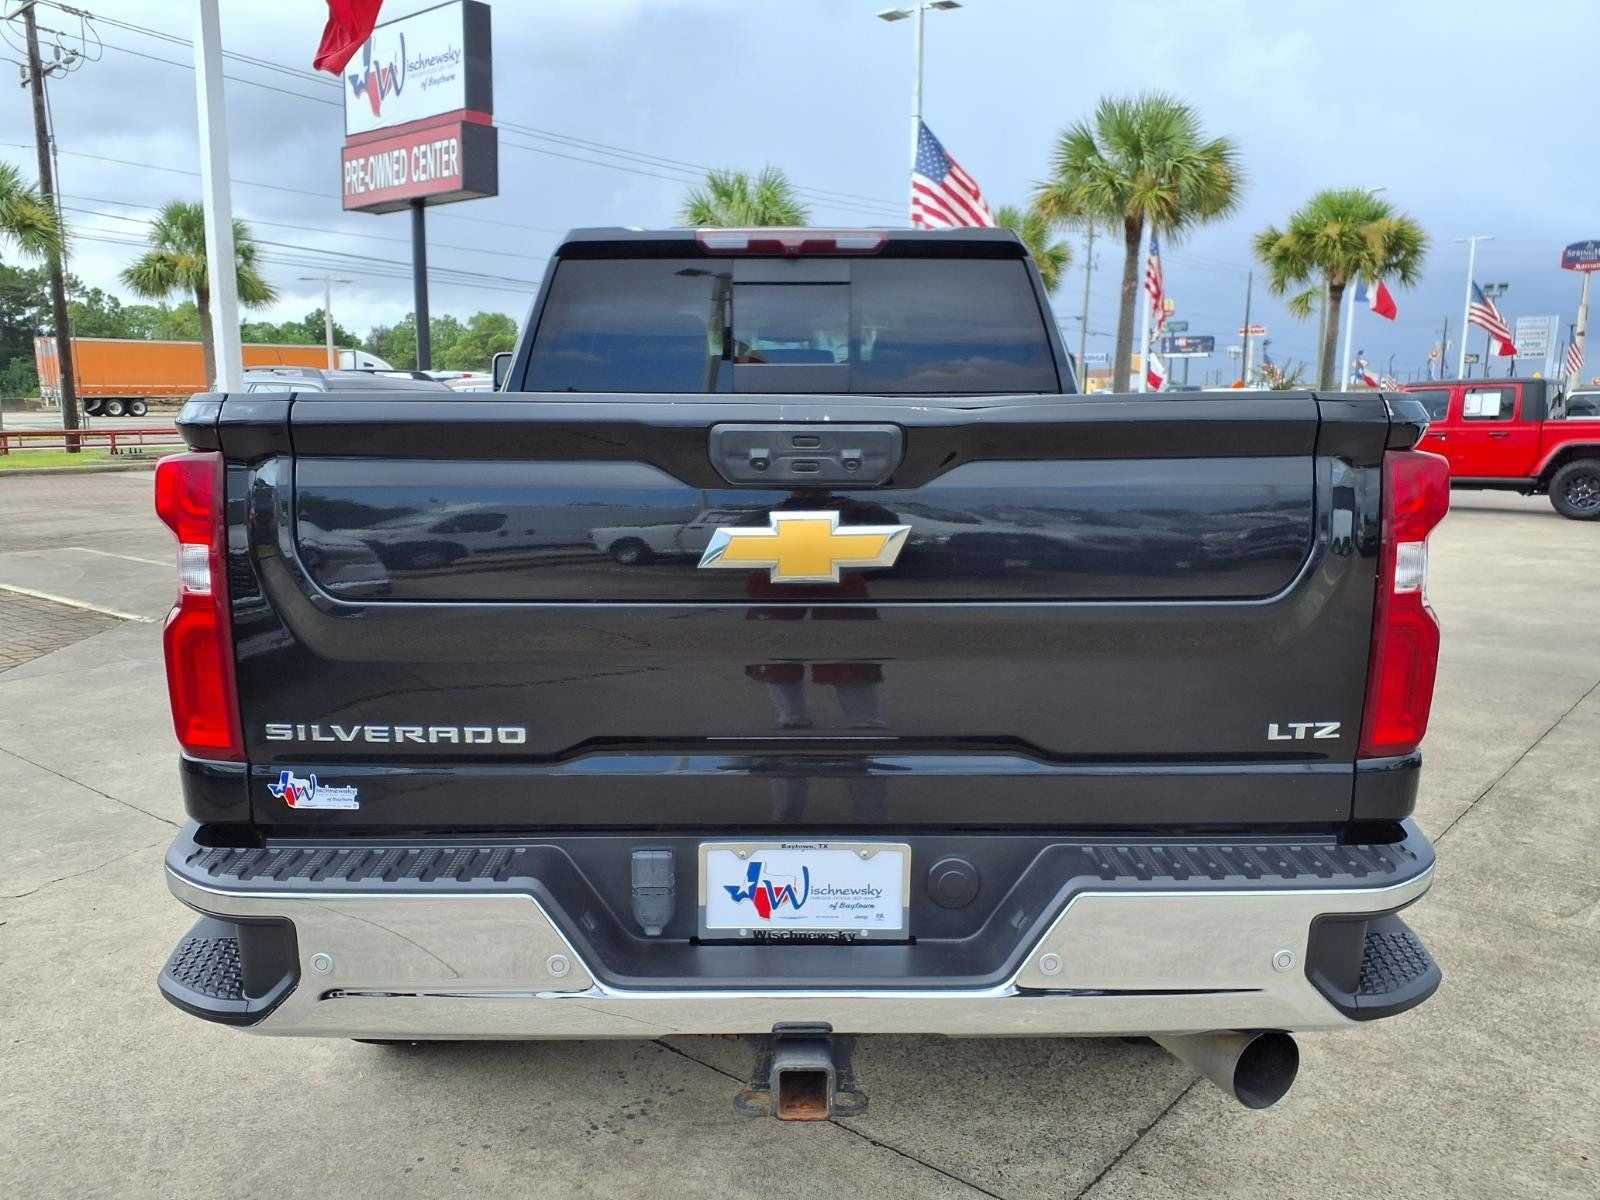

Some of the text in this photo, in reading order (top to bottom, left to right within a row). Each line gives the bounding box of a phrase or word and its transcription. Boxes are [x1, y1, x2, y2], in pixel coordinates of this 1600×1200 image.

[373, 32, 461, 101] Wischnewsky
[344, 138, 459, 196] PRE-OWNED CENTER
[265, 723, 527, 744] SILVERADO
[1267, 721, 1341, 741] LTZ
[763, 865, 883, 910] Wischnewsky
[839, 902, 875, 910] Baytown
[752, 929, 857, 942] Wischnewsky
